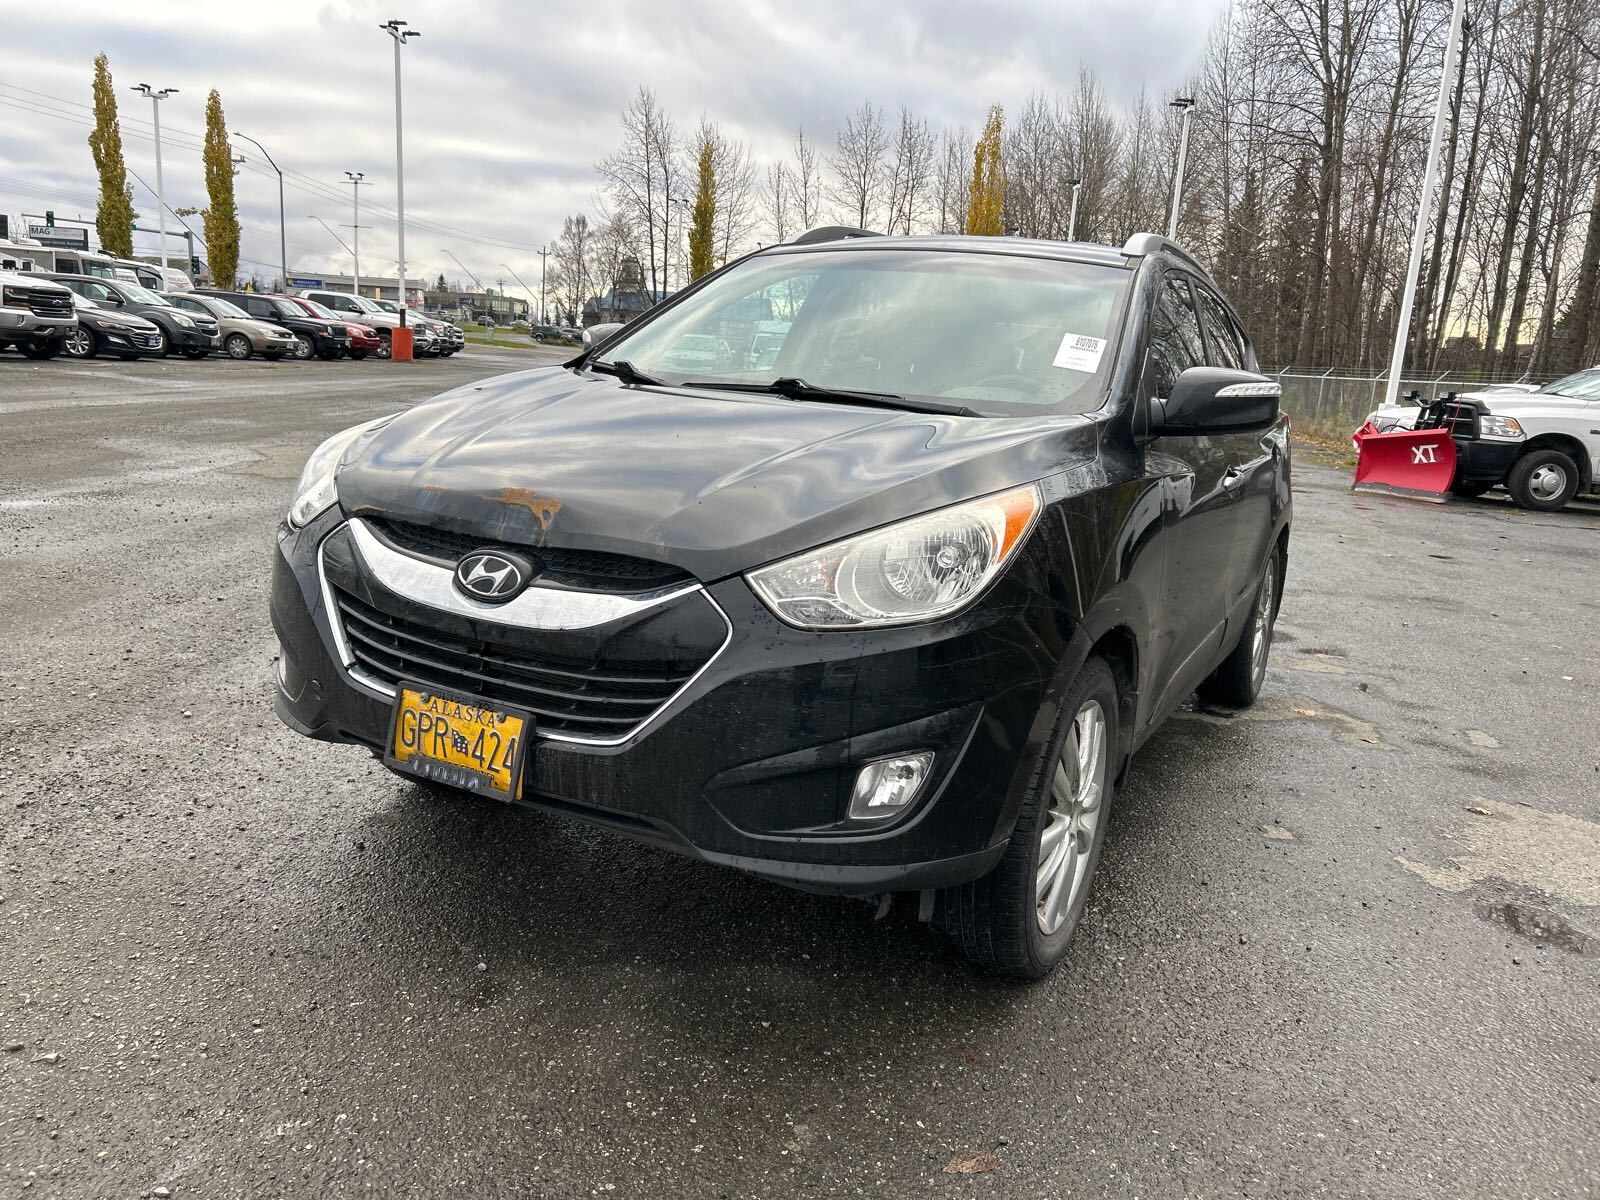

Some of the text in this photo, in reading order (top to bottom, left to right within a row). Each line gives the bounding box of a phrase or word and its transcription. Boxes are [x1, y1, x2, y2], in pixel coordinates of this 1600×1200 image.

[31, 227, 51, 235] MAG
[1411, 444, 1439, 464] XT
[429, 699, 496, 728] ALASKA
[401, 709, 449, 758] GPR
[471, 728, 517, 774] 424
